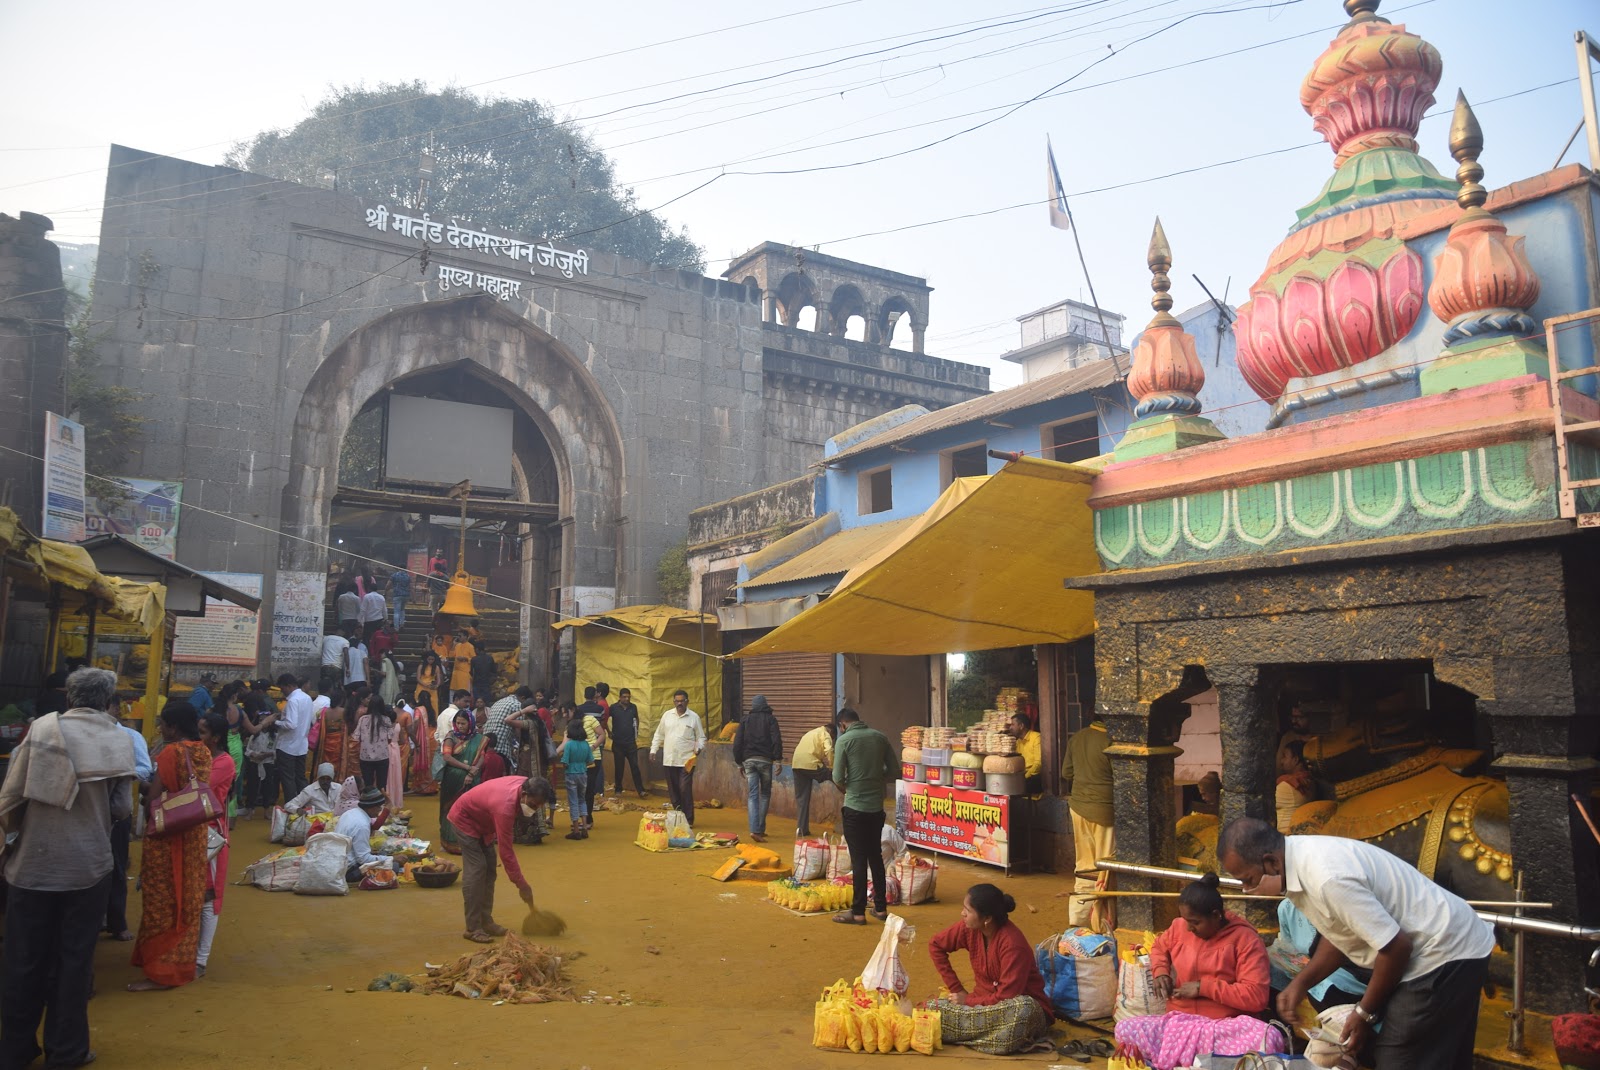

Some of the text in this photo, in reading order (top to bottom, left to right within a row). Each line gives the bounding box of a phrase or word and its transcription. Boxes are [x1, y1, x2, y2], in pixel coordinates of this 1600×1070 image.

[365, 204, 390, 232] श्री
[392, 212, 444, 244] मार्तंड
[537, 241, 589, 279] जेजुरी
[438, 265, 522, 301] मुख्य महाद्वार
[85, 517, 107, 530] OT
[141, 526, 162, 537] 300
[911, 788, 1002, 826] साई समर्थ प्रसादालय
